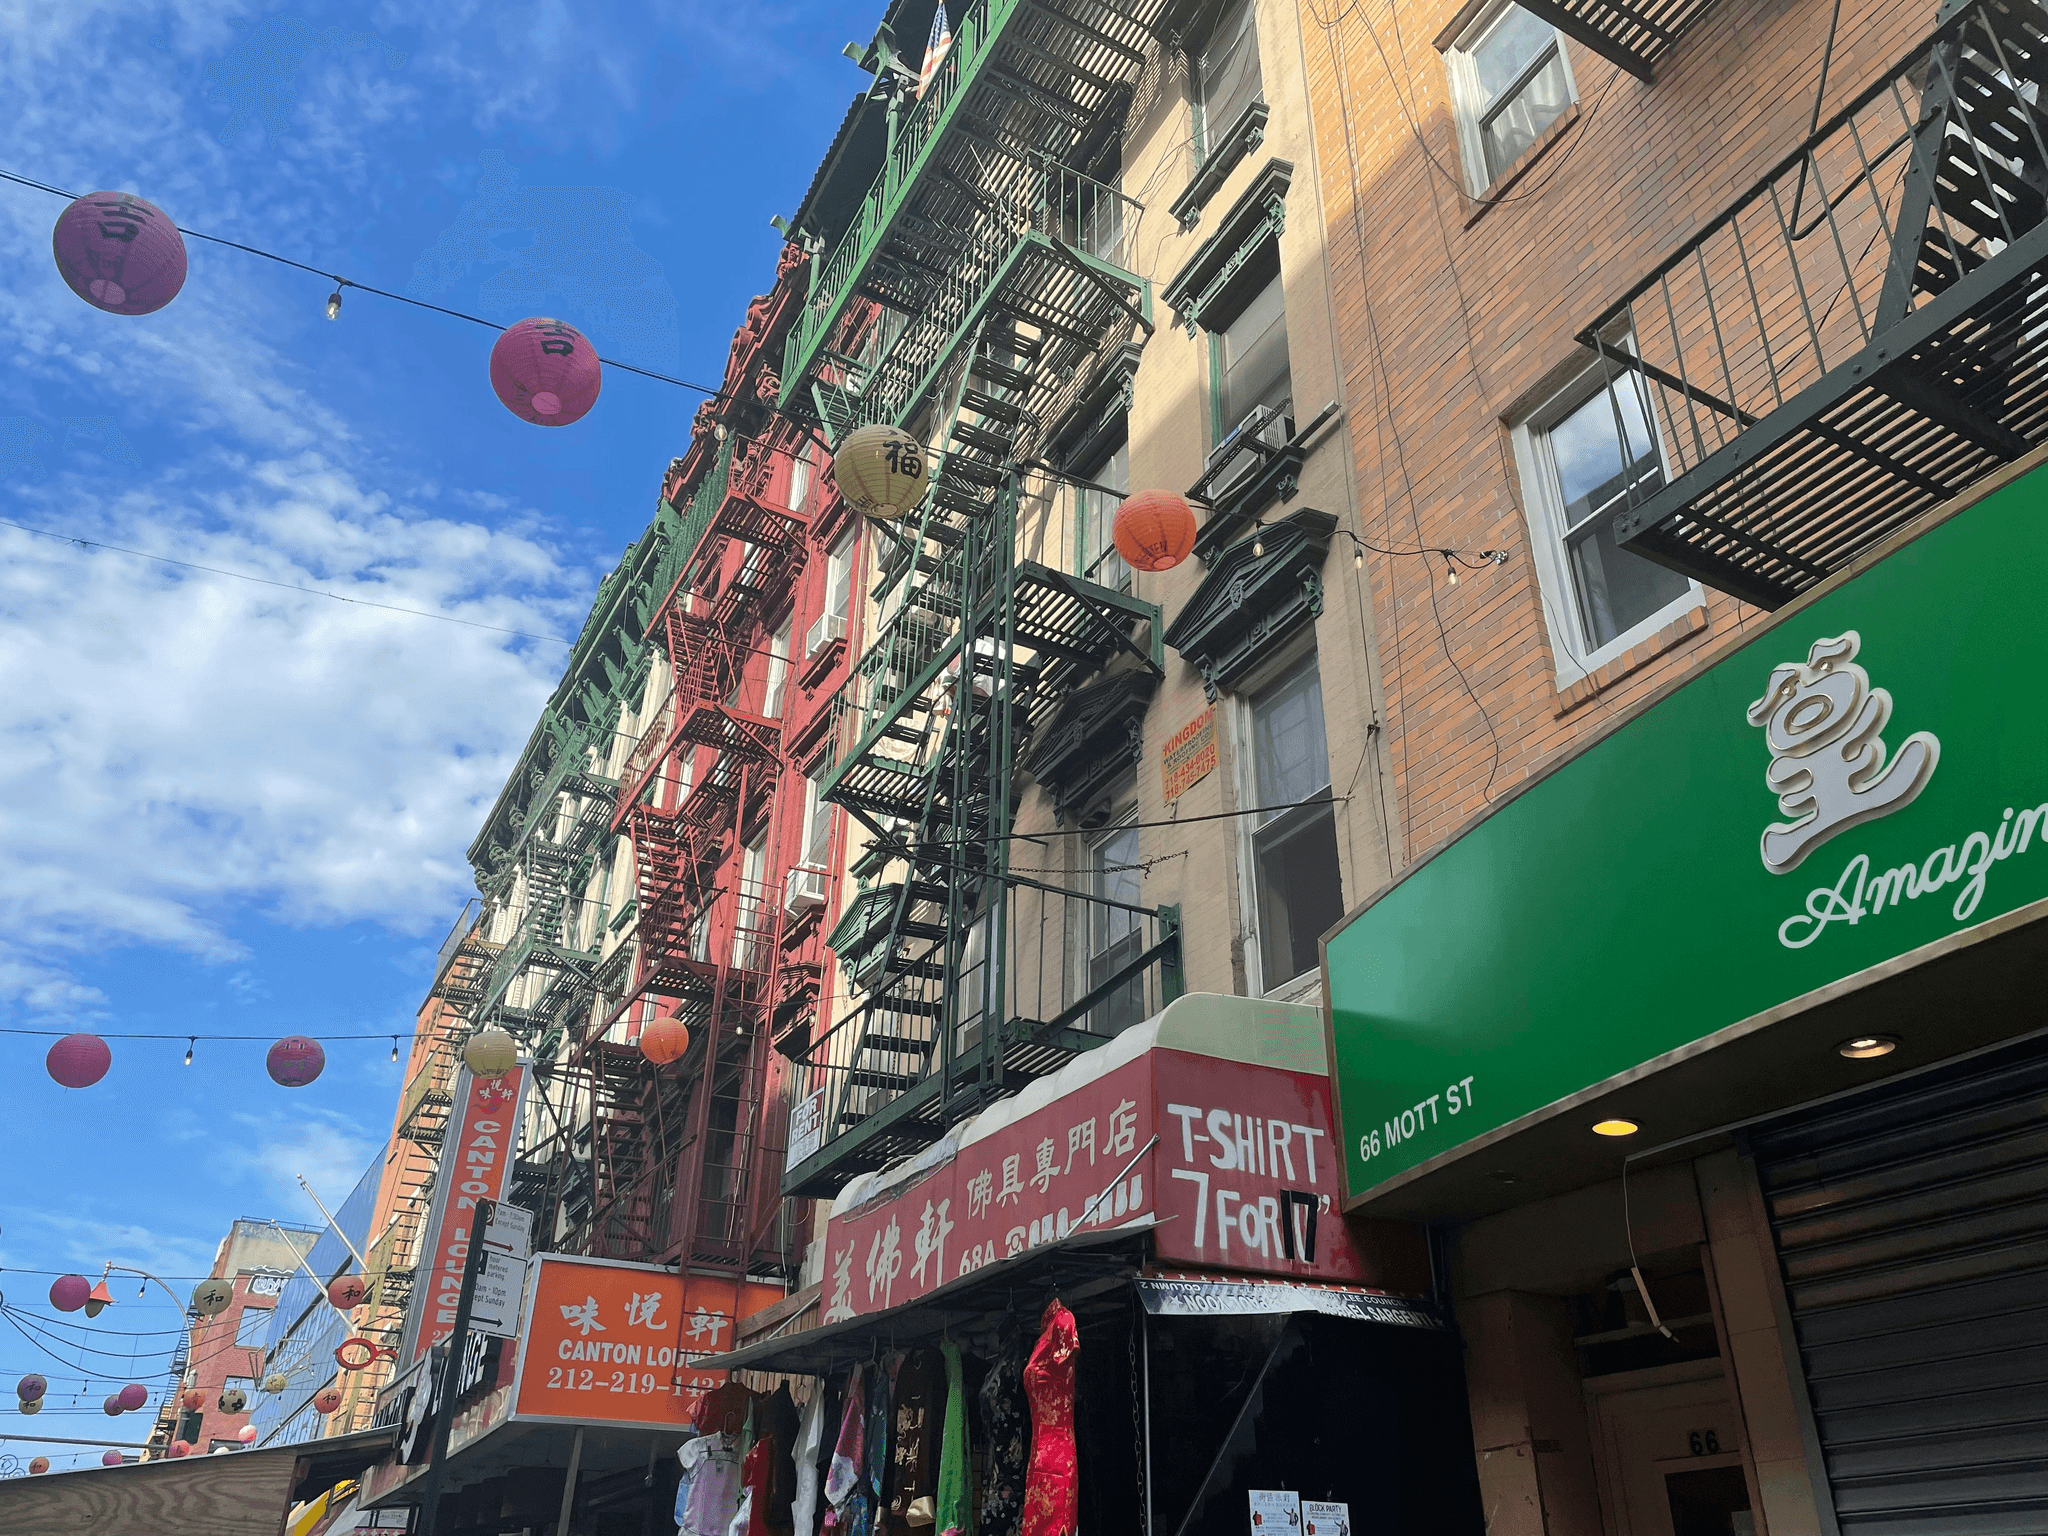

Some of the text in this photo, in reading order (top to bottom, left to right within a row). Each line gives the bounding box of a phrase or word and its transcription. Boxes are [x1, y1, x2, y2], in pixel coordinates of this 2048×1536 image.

[883, 430, 922, 479] 福
[1164, 708, 1213, 756] KINGDOM
[1164, 722, 1214, 765] WATERPROOFING
[1173, 741, 1199, 764] ROOFING
[796, 1098, 817, 1126] FOR
[1360, 1075, 1474, 1162] 66 MOTT ST
[791, 1110, 820, 1145] RENT
[457, 1120, 501, 1209] CANTON
[1171, 1168, 1209, 1248] 7
[495, 1217, 525, 1234] Except Sunday
[488, 1263, 508, 1274] metered
[489, 1254, 500, 1263] hour
[959, 1239, 996, 1276] 68A
[486, 1271, 505, 1282] parking
[1139, 1281, 1201, 1291] COLUMN 2
[203, 1289, 225, 1306] 和
[341, 1284, 361, 1299] 和
[485, 1294, 506, 1309] Sunday
[1182, 1293, 1229, 1311] YOON
[1344, 1293, 1363, 1303] LEE
[558, 1339, 641, 1365] CANTON
[1690, 1430, 1719, 1455] 66
[1309, 1503, 1343, 1514] BLOCK PARTY
